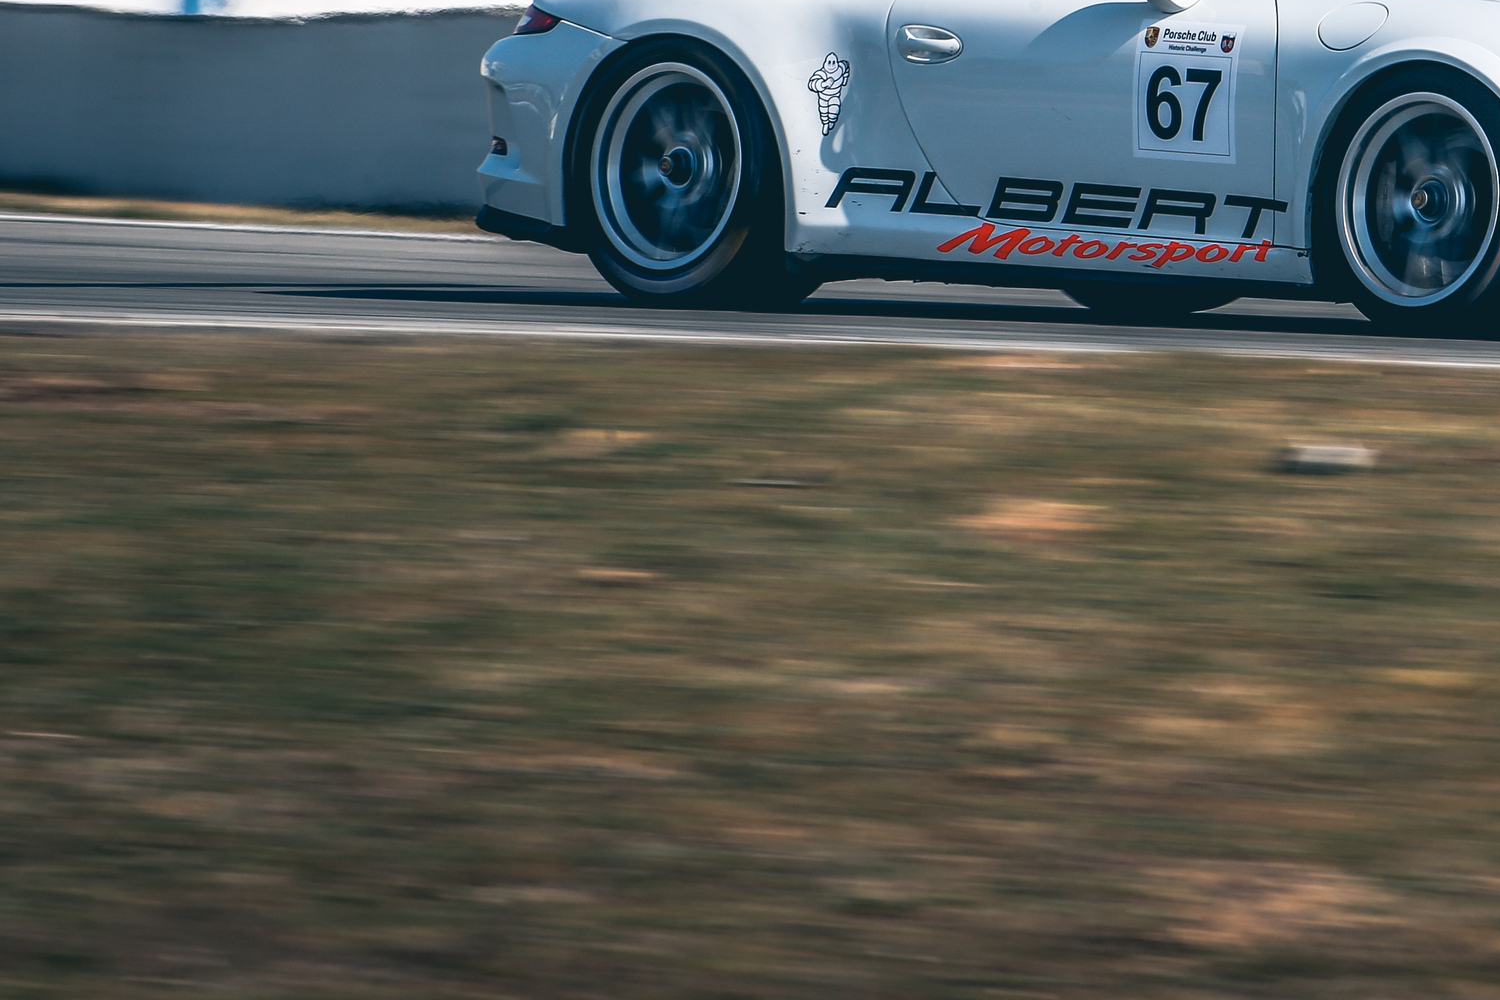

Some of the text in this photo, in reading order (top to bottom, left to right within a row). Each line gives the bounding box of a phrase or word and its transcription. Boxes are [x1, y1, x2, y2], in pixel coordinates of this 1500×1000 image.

[1163, 28, 1217, 42] Porsche Club
[1168, 44, 1207, 54] Historic Challenge
[1145, 65, 1223, 142] 67
[824, 166, 1289, 239] ALBERT
[936, 222, 1273, 268] Motorsport
